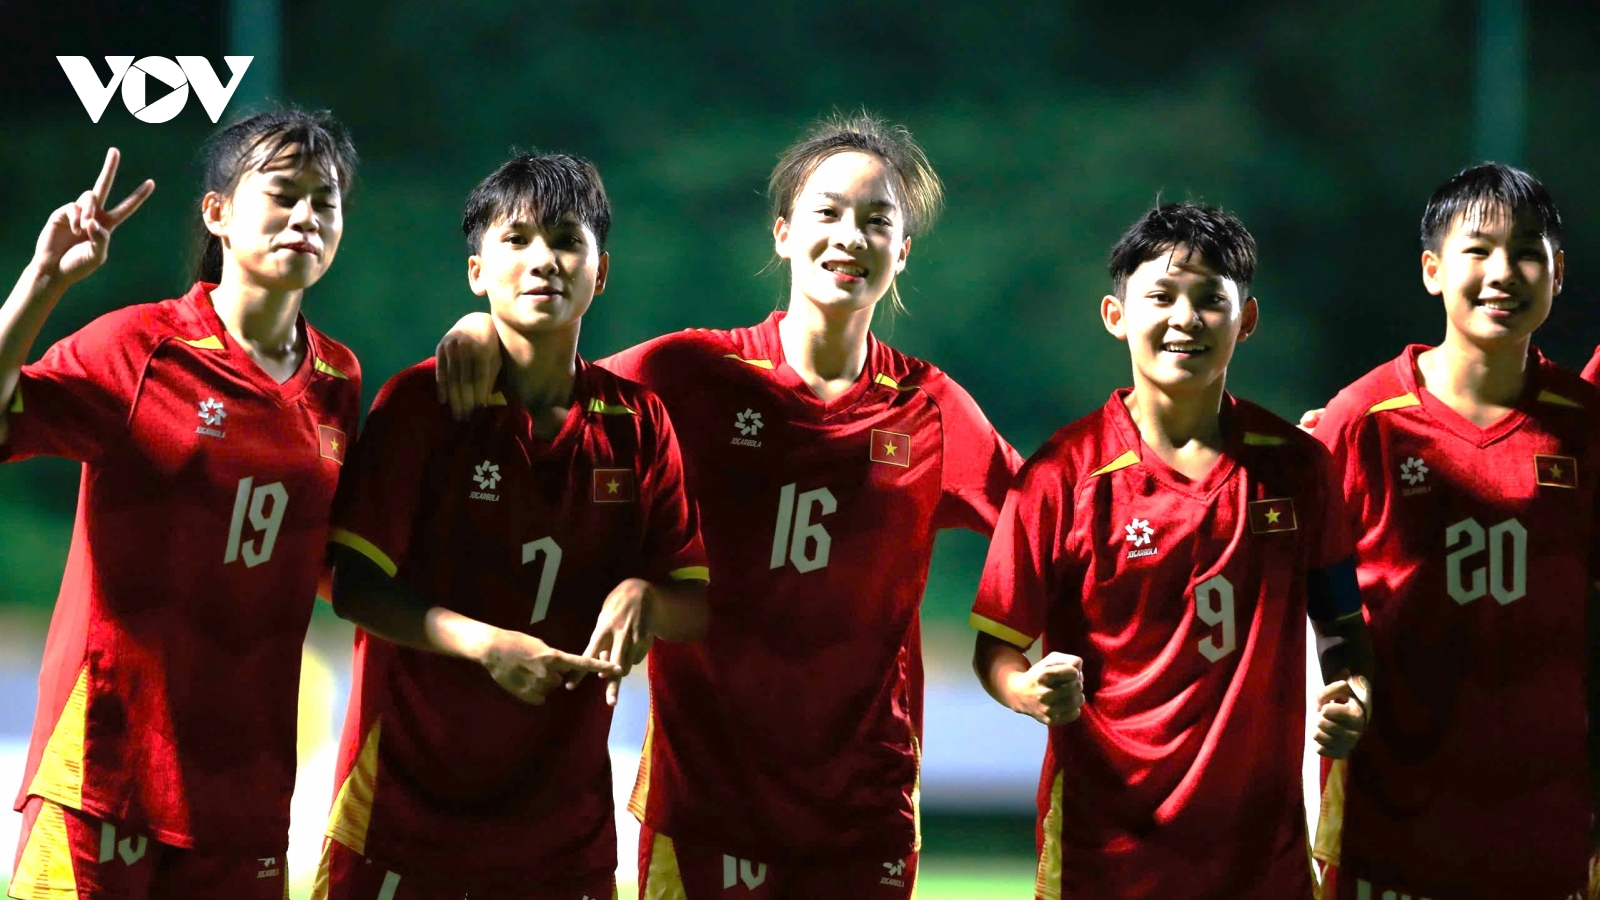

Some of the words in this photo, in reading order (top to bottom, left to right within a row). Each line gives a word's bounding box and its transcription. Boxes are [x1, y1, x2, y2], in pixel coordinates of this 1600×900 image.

[225, 477, 288, 567] 19
[770, 484, 837, 573] 16
[1446, 518, 1528, 605] 20
[522, 537, 562, 623] 7
[1195, 575, 1236, 662] 9
